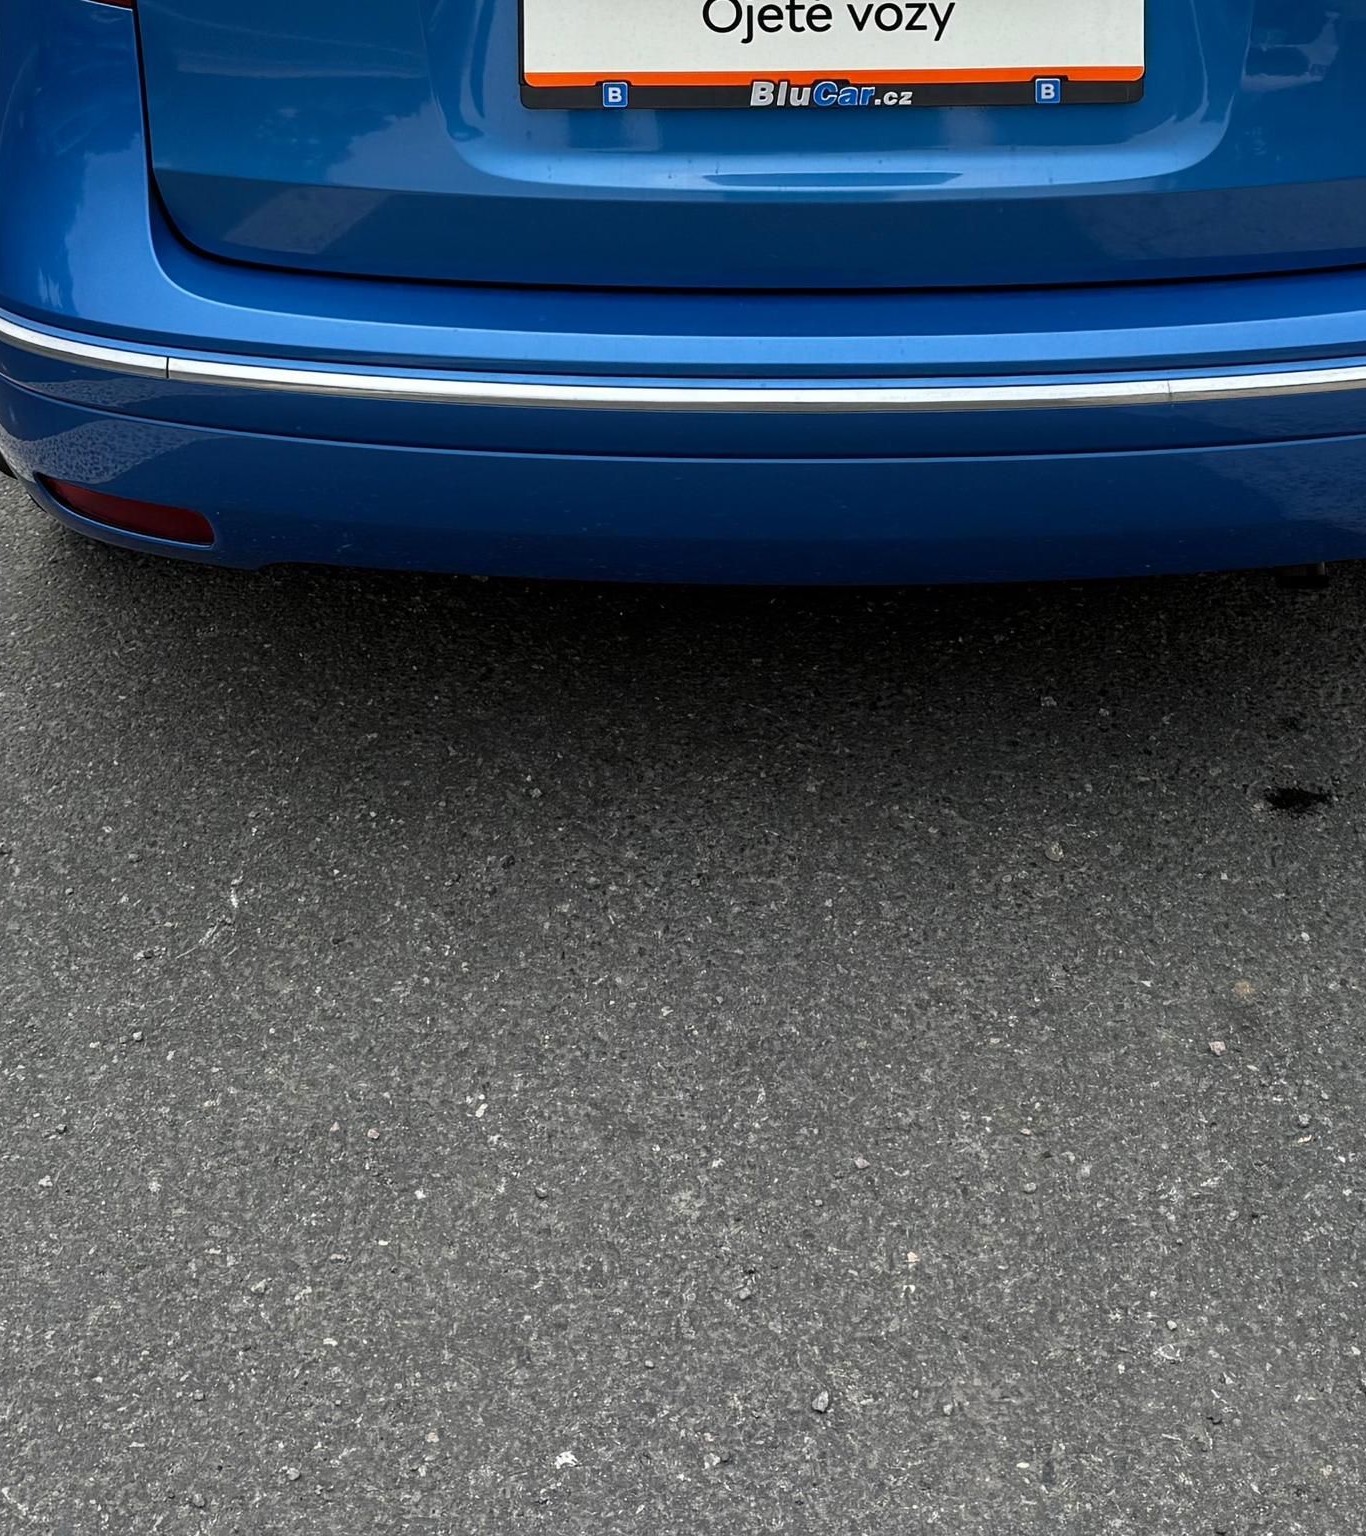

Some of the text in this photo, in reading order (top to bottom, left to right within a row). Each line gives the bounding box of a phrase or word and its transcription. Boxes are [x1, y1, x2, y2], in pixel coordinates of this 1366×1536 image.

[846, 1, 956, 42] vozy
[608, 86, 623, 103] B
[749, 80, 914, 108] BluCar.cz
[1040, 83, 1055, 100] B
